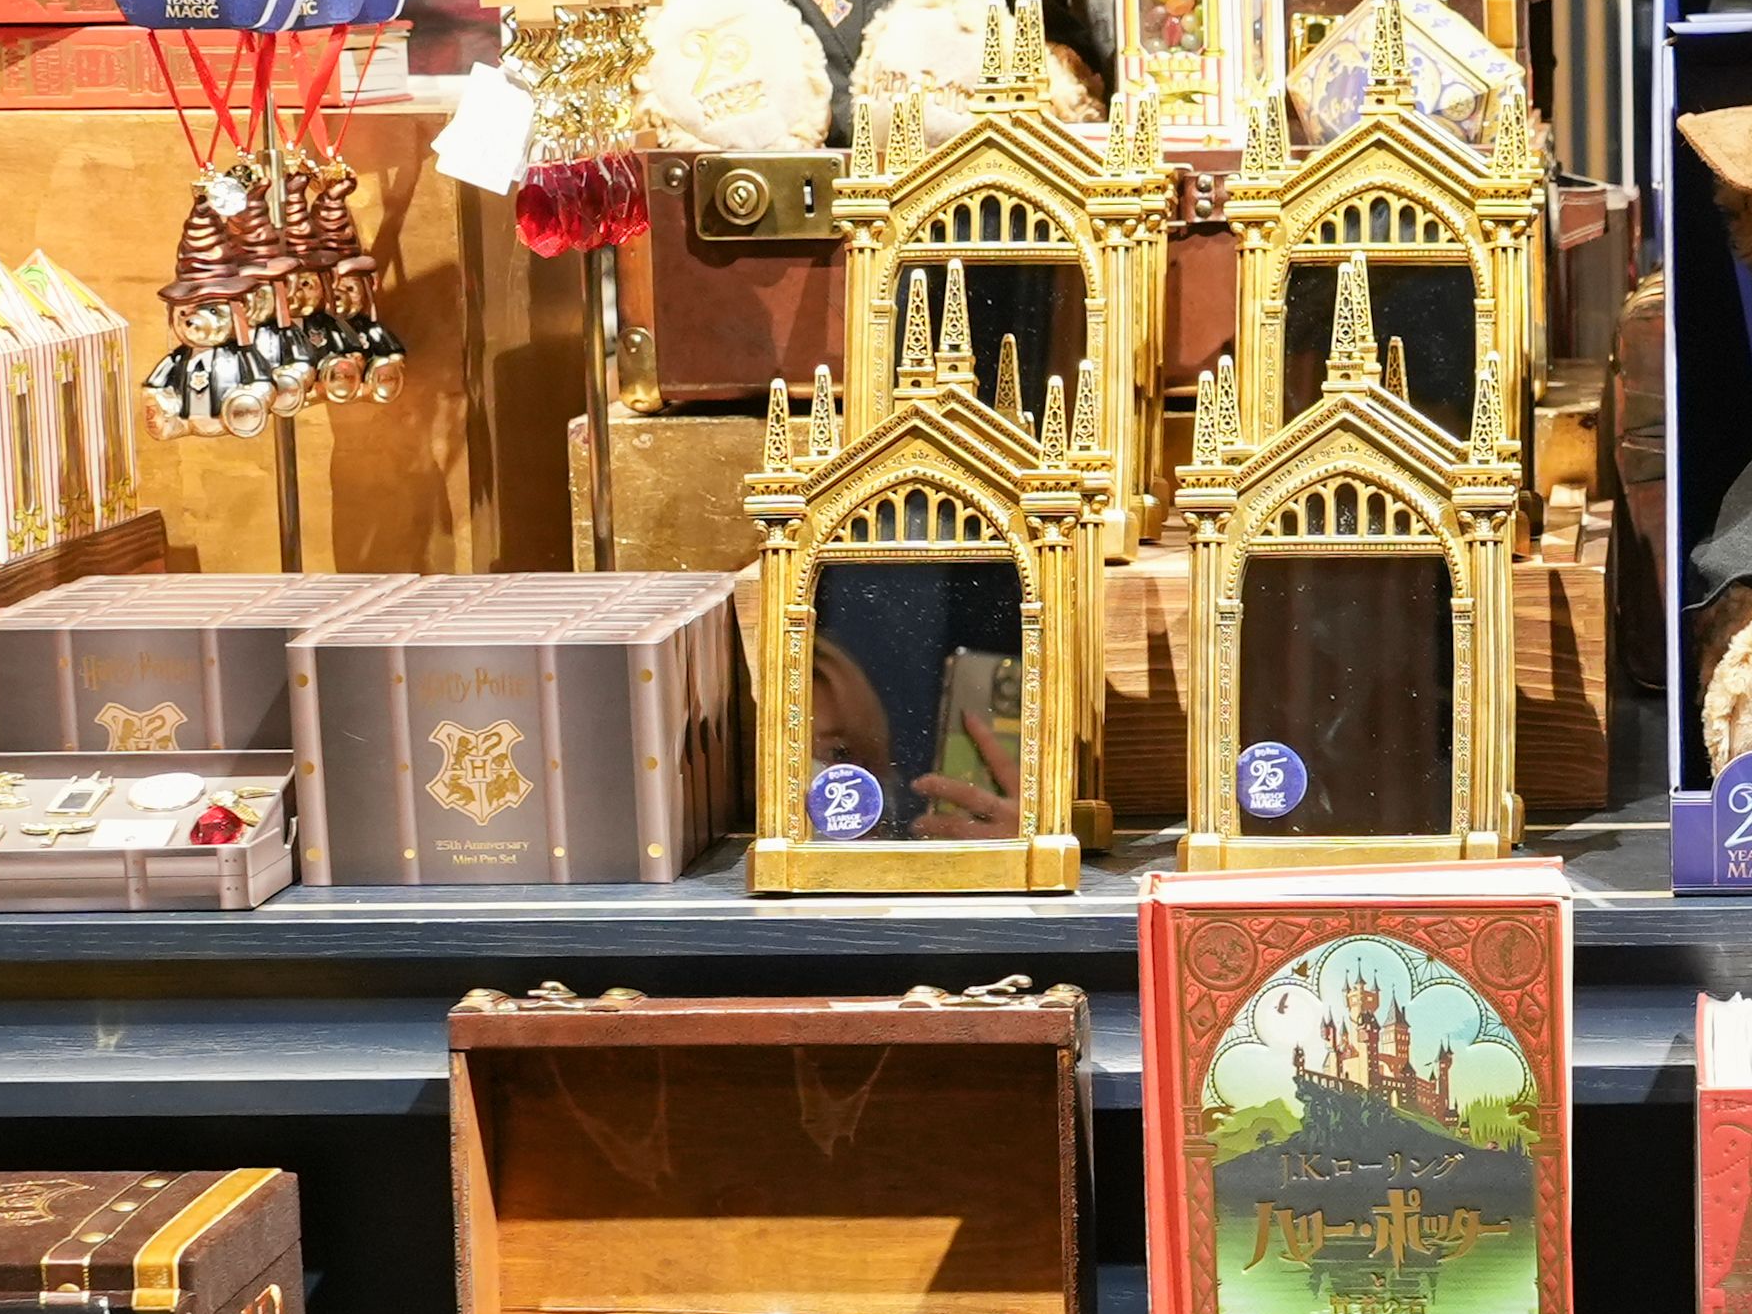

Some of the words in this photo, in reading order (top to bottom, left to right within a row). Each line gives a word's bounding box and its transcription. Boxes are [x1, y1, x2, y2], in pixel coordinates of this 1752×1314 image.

[165, 5, 219, 19] MAGIC
[80, 654, 137, 691] Harry
[470, 758, 489, 779] H
[1249, 756, 1287, 794] 25
[824, 778, 862, 817] 25
[1250, 798, 1287, 809] MAGIC
[826, 821, 862, 831] MAGIC
[434, 839, 460, 851] 25th
[462, 839, 529, 852] Anniversary
[452, 853, 475, 865] Mini
[478, 853, 496, 865] Pin
[499, 853, 517, 865] Set
[1279, 1152, 1465, 1189] J.K.ローリング
[1241, 1187, 1512, 1279] ハリー・ポッター
[1369, 1271, 1386, 1289] と
